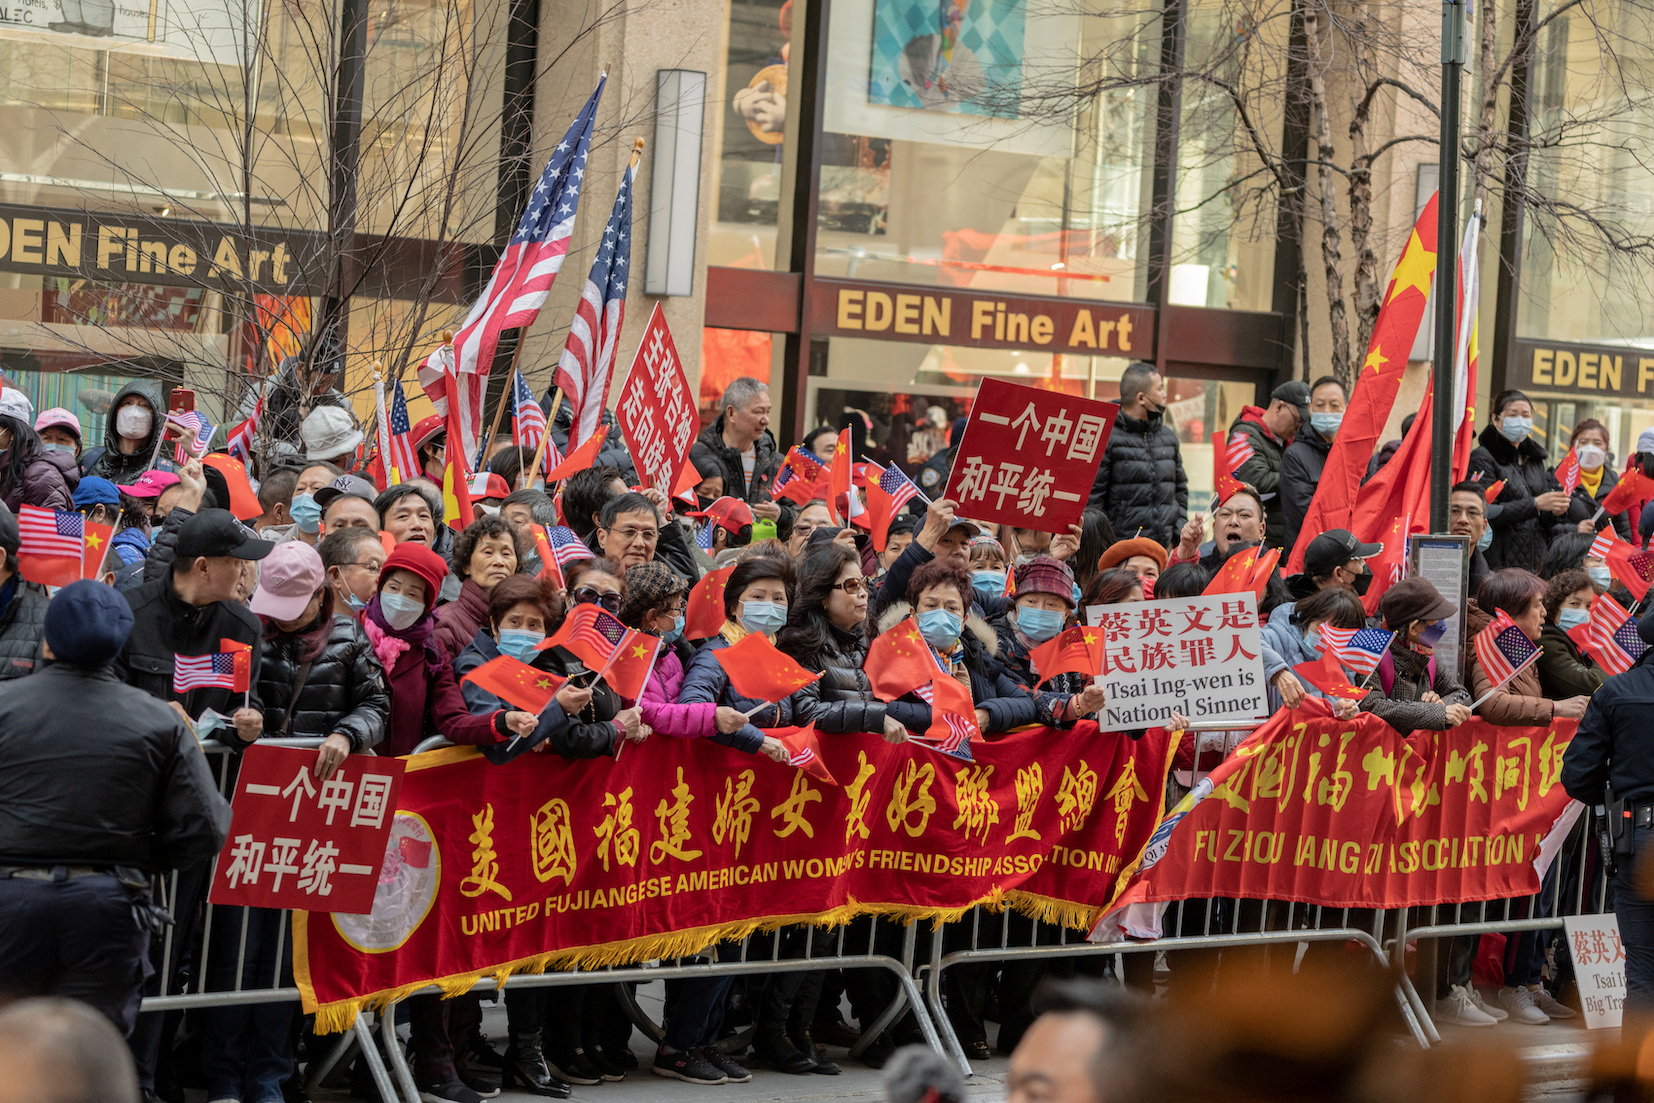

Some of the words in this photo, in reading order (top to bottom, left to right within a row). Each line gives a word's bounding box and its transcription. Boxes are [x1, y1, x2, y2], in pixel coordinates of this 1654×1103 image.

[97, 225, 197, 276] Fine
[207, 235, 290, 285] Art
[837, 289, 951, 336] EDEN
[970, 300, 1054, 345] Fine
[1068, 309, 1133, 351] Art
[643, 327, 693, 463] 主张台独
[1532, 348, 1623, 391] EDEN
[979, 401, 1106, 463] 一个中国
[956, 456, 1081, 517] 和平统一
[1093, 600, 1255, 642] 蔡英文是
[1103, 634, 1258, 677] 民族罪人
[1106, 678, 1148, 700] Tsai
[1152, 673, 1233, 698] Ing-wen
[1239, 668, 1255, 686] is
[1106, 699, 1190, 726] National
[1195, 695, 1261, 717] Sinner
[245, 765, 393, 830] 一个中国
[225, 833, 373, 896] 和平统一
[461, 902, 540, 936] UNITED
[544, 876, 672, 918] FUJIANGESE
[674, 861, 778, 895] AMERICAN
[869, 849, 991, 877] FRIENDSHIP
[992, 844, 1104, 875] ASSOTION
[1571, 928, 1626, 966] 蔡英文
[1585, 995, 1605, 1016] Big
[1593, 972, 1616, 989] Tsai
